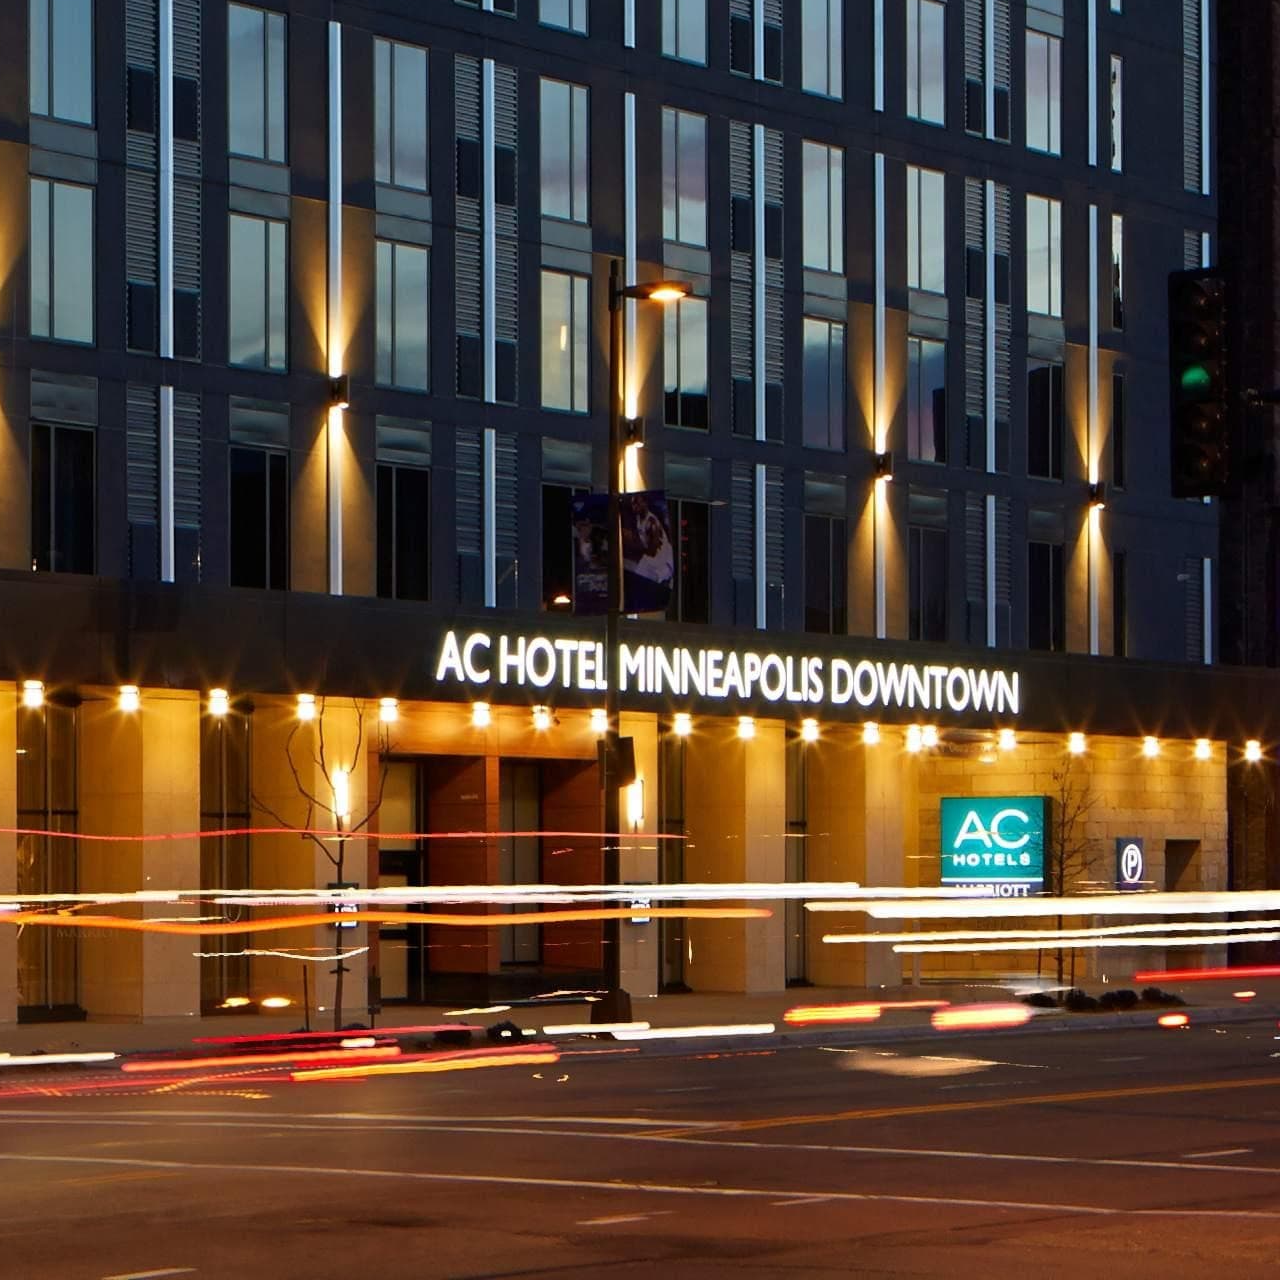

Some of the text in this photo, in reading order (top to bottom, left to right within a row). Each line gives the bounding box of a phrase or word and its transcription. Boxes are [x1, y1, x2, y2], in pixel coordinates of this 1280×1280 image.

[436, 630, 1021, 715] AC HOTEL MINNEAPOLIS DOWNTOWN
[954, 808, 1030, 849] AC
[953, 852, 1031, 867] HOTELS
